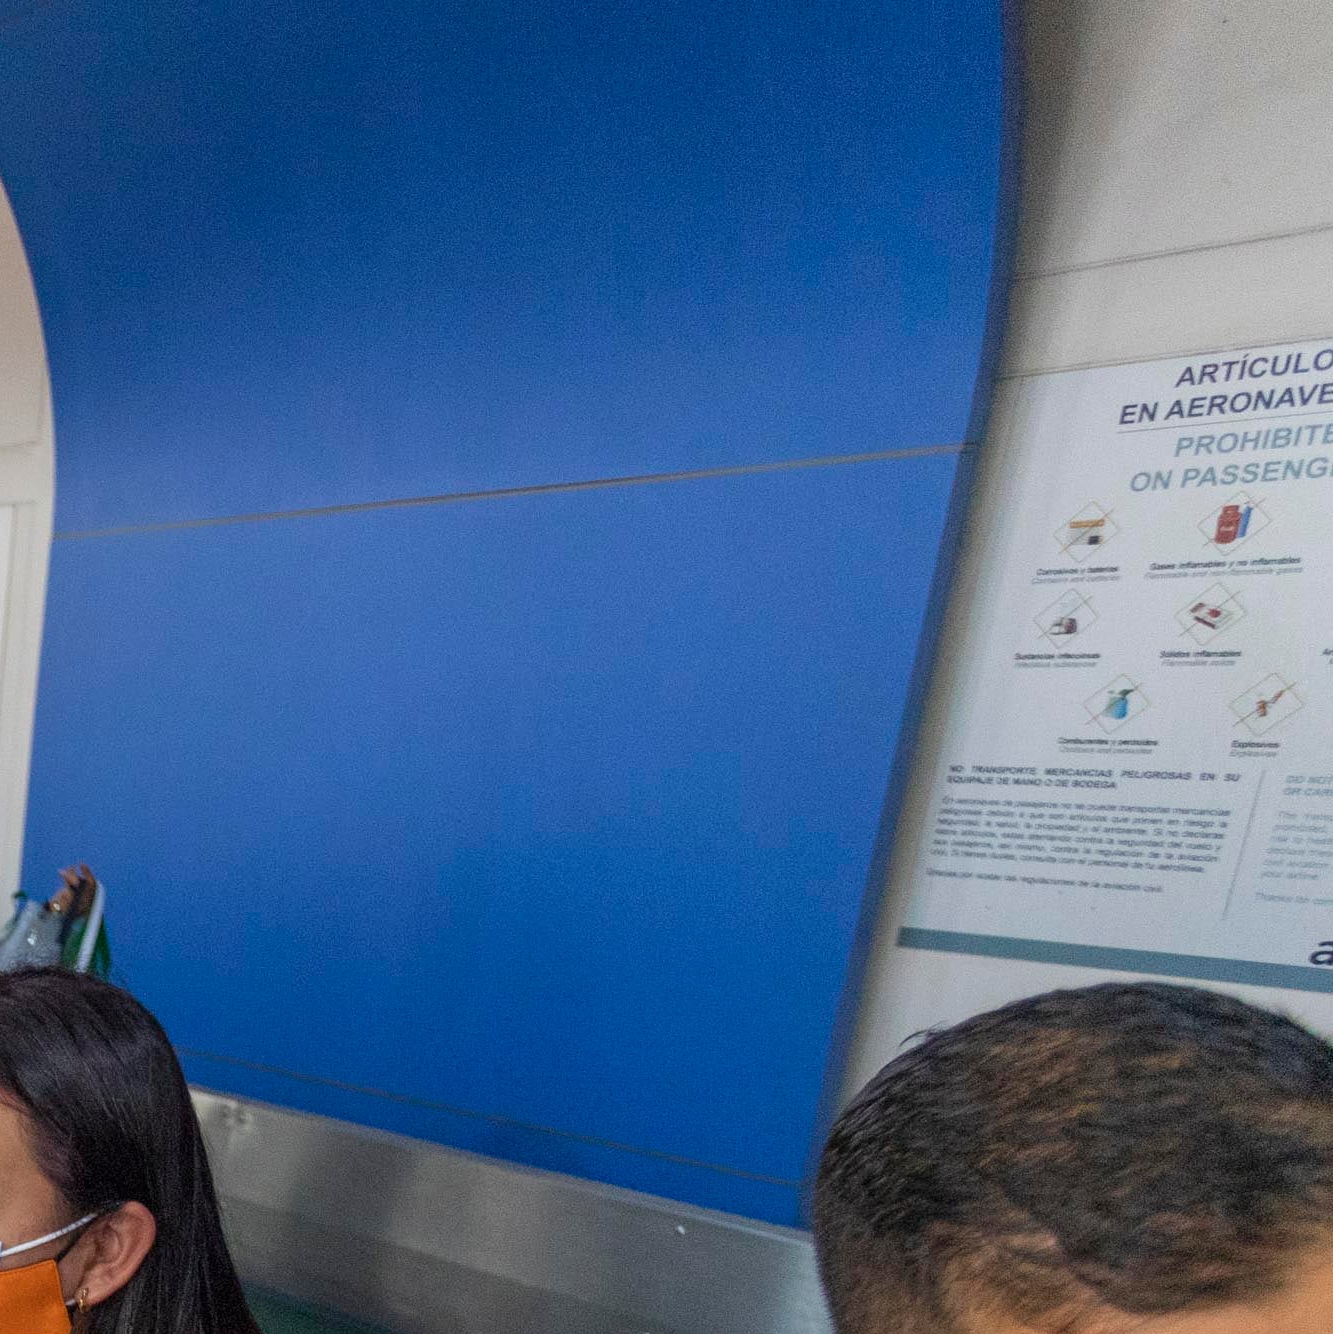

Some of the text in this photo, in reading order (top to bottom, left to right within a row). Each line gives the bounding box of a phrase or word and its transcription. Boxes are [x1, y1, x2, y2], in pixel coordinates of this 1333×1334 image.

[1174, 348, 1333, 388] ARTÍCULO
[1119, 383, 1333, 425] EN AERONAVE
[1174, 421, 1333, 458] PROHIBITE
[1130, 455, 1333, 493] ON PASSENG
